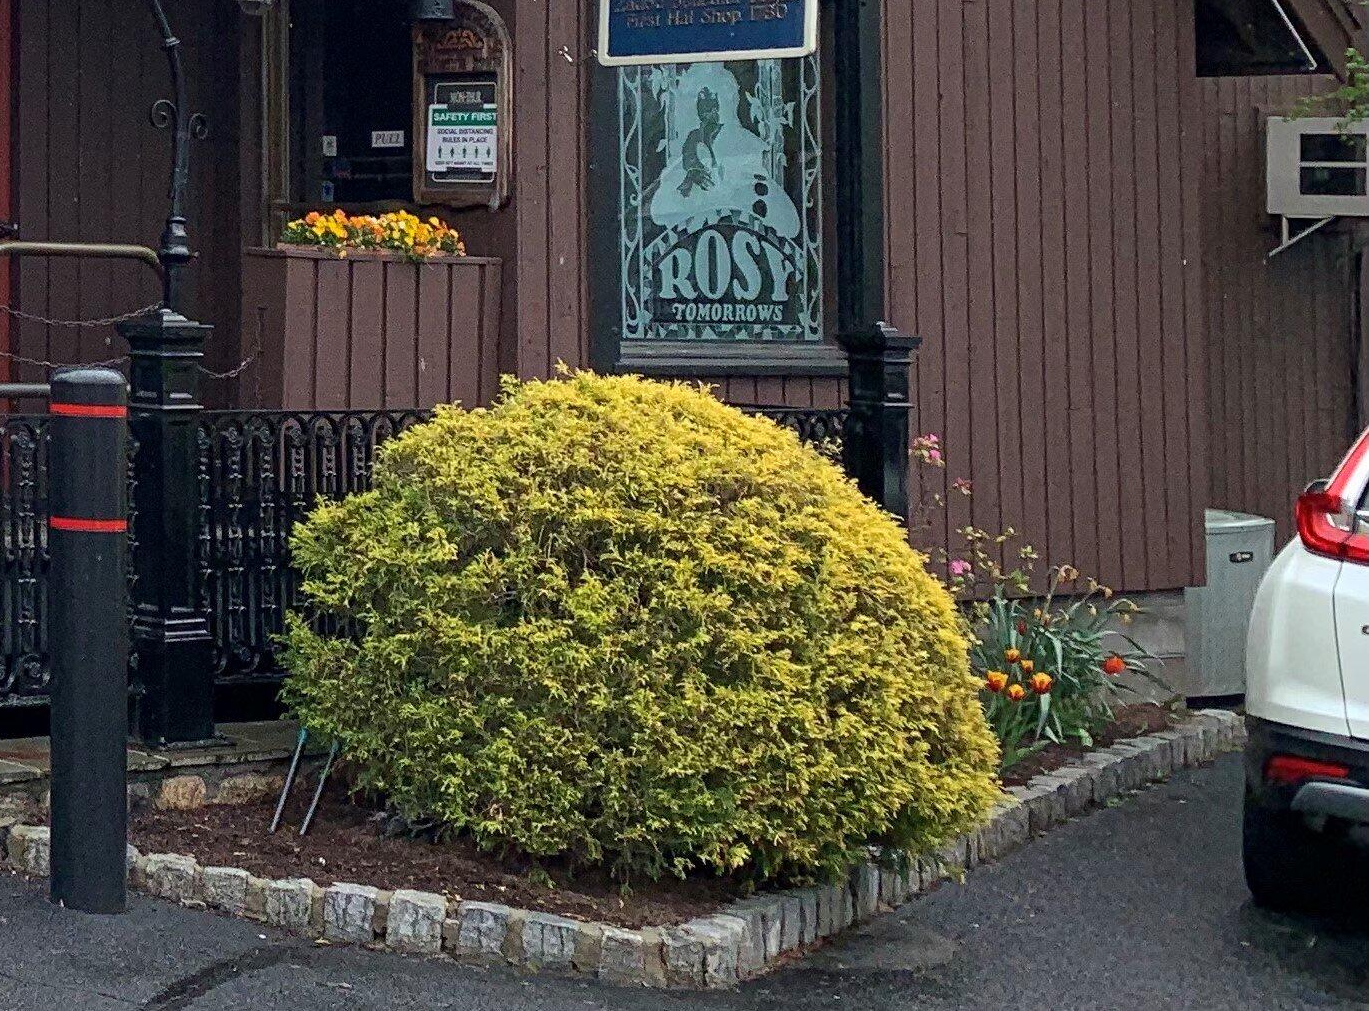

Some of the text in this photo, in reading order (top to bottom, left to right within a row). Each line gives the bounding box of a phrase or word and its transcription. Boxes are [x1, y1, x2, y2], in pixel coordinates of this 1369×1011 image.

[434, 112, 497, 121] SAFETY FIRST
[658, 229, 795, 301] ROSY
[671, 302, 783, 322] TOMORROWS
